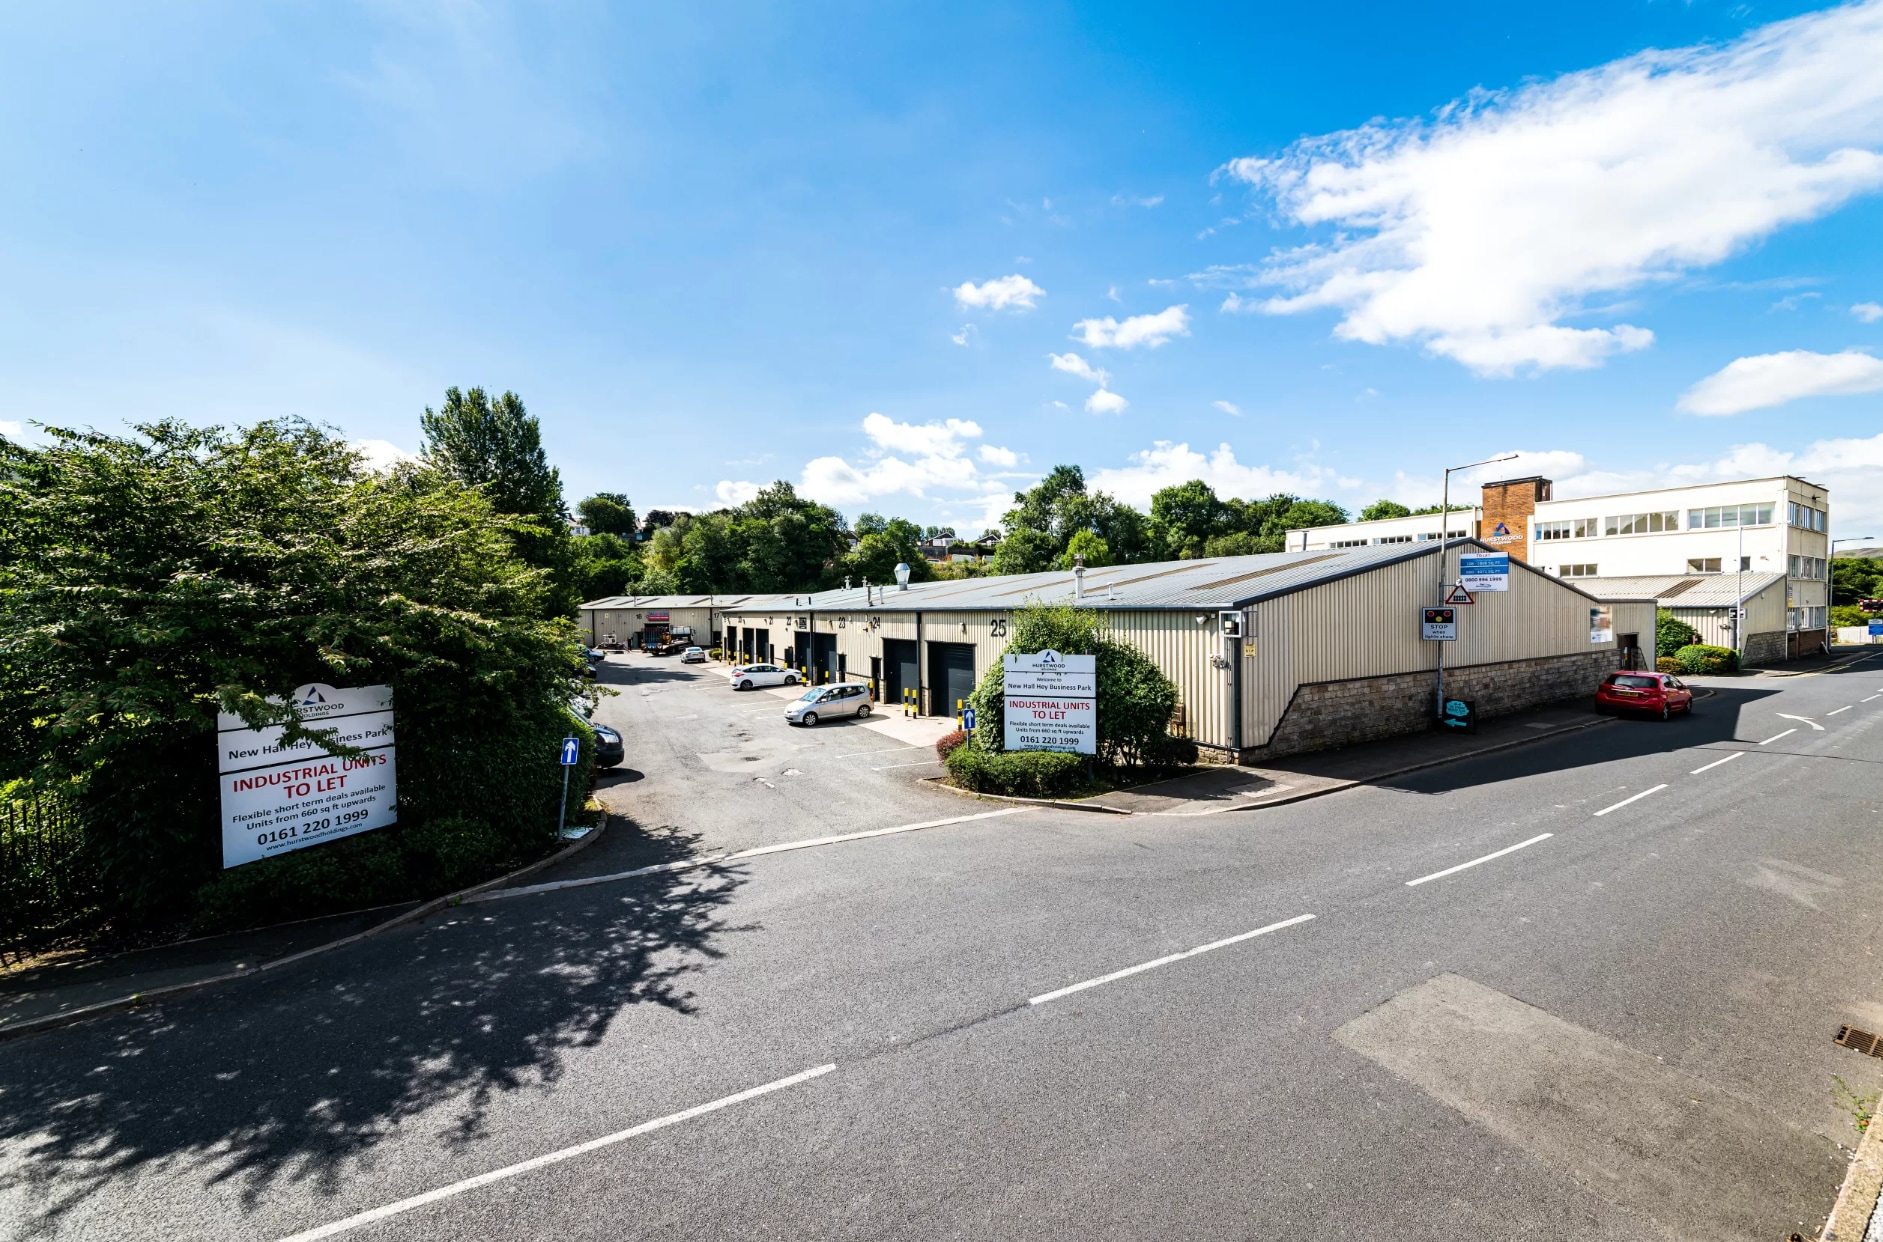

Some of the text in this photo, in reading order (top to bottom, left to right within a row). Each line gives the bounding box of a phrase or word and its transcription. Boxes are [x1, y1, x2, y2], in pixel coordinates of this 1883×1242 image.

[838, 616, 846, 629] 23
[872, 616, 881, 629] 24
[990, 619, 1007, 637] 25
[293, 703, 345, 714] RSTWOOD
[1009, 700, 1090, 710] INDUSTRIAL UNITS
[300, 711, 330, 719] OLDINGS
[1032, 710, 1067, 720] TO LET
[228, 749, 259, 760] New
[290, 741, 312, 750] Hey
[365, 728, 388, 739] Park
[1020, 735, 1080, 746] 0161 220 1999
[233, 753, 387, 793] INDUSTRIAL UNITS
[283, 774, 348, 799] TO LET
[232, 784, 386, 824] Flexible short term deals available
[246, 795, 377, 831] Units from 660 sq ft upwards
[257, 809, 369, 846] 0161 220 1999
[266, 822, 363, 851] www.hurstwoodholdings.com
